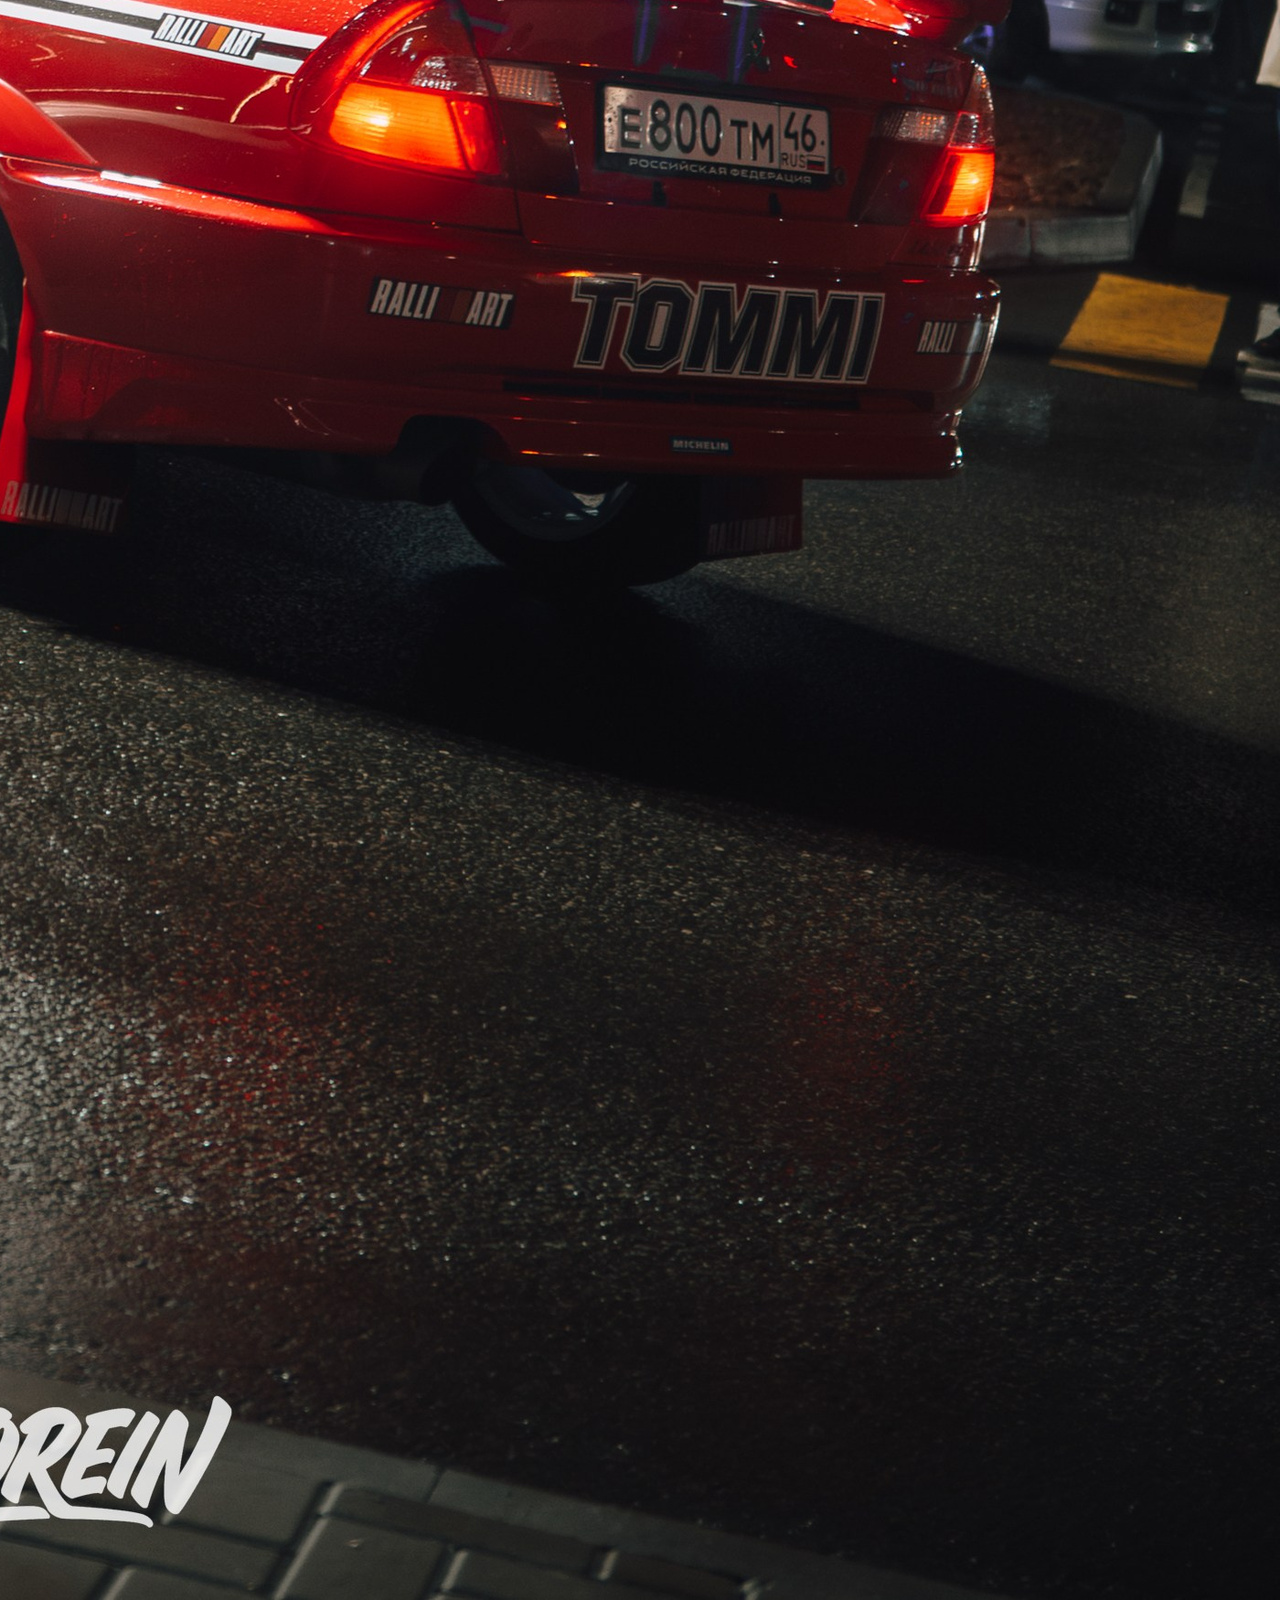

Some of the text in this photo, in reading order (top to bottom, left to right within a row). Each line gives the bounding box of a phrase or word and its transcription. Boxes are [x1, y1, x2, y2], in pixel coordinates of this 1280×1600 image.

[784, 110, 816, 152] 46
[629, 157, 812, 184] РОССИЙСКАЯ ФЕДЕРАЦИЯ
[782, 152, 805, 169] RUS
[571, 272, 886, 385] TOMMI
[673, 440, 729, 451] MICHELIN
